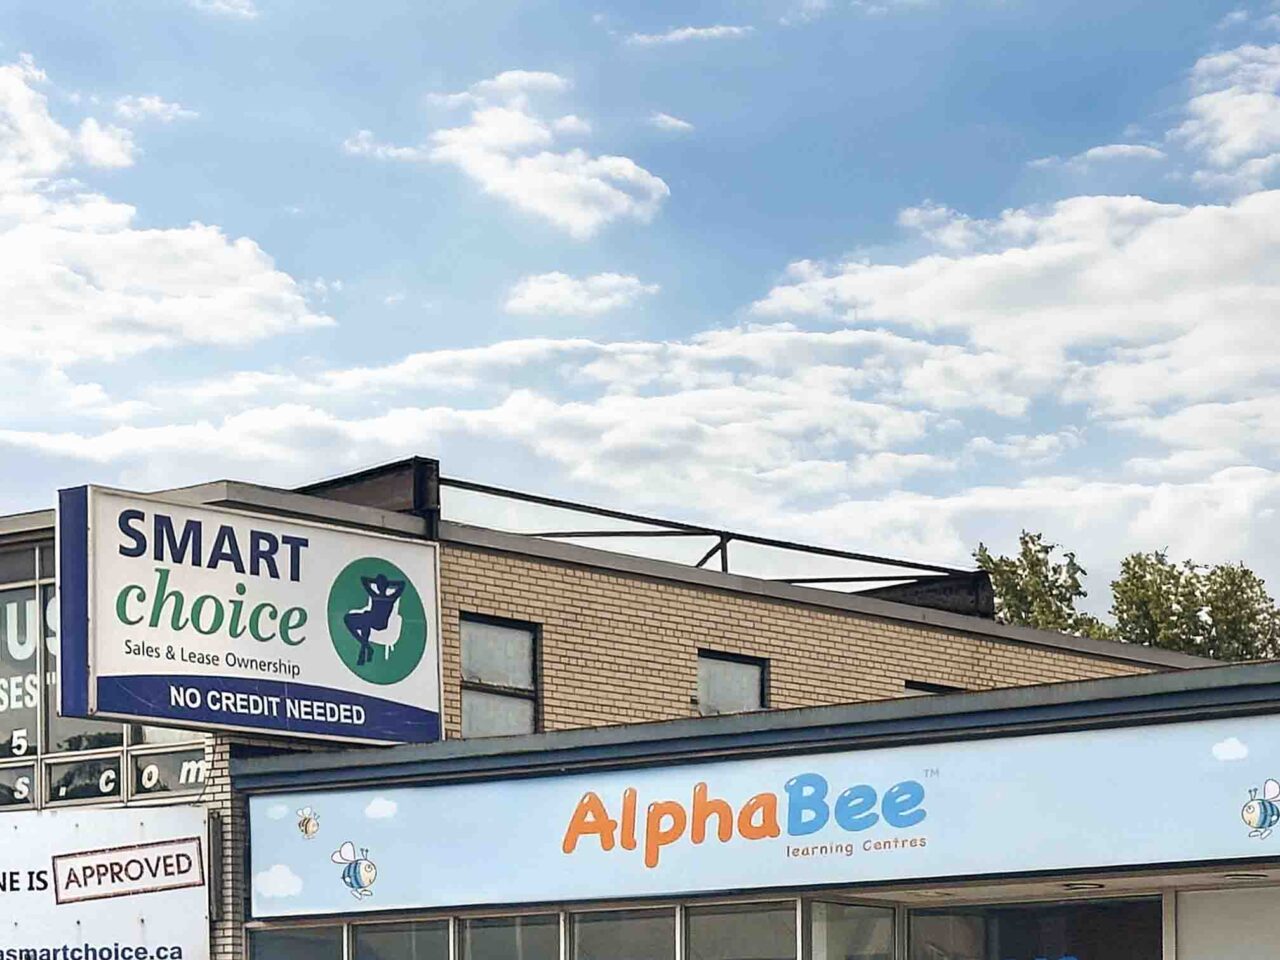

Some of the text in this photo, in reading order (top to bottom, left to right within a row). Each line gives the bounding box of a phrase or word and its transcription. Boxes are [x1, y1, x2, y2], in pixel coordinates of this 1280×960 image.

[118, 509, 309, 582] SMART
[116, 568, 308, 646] choice
[124, 639, 301, 678] Sales & Lease Ownership
[170, 685, 366, 725] NO CREDIT NEEDED
[562, 772, 928, 868] AlphaBee
[786, 835, 928, 857] learning Centres
[27, 870, 48, 891] IS
[64, 853, 193, 890] APPROVED
